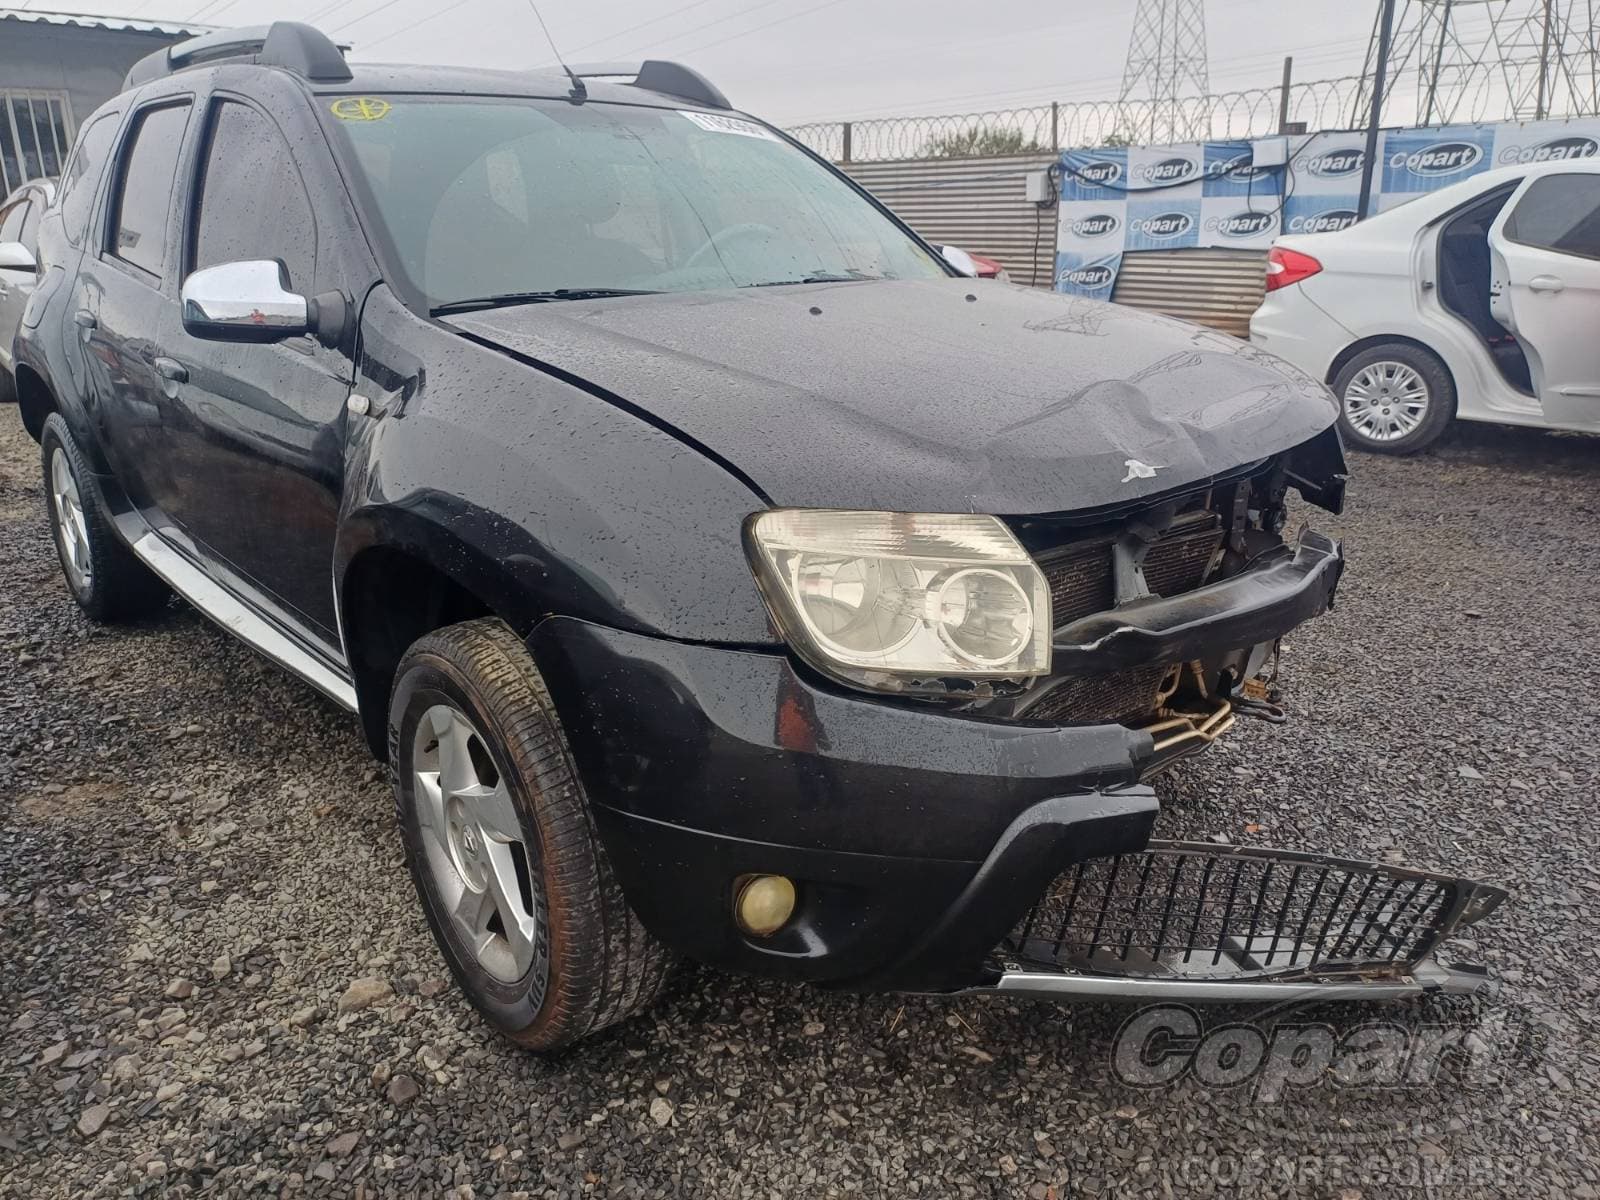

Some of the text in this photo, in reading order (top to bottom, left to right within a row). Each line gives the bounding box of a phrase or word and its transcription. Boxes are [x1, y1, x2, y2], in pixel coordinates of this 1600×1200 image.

[1390, 148, 1472, 172] Copart
[1499, 141, 1594, 163] Copart
[1064, 165, 1114, 182] Cpart
[1132, 161, 1189, 181] Copart
[1063, 218, 1113, 233] Copart
[1130, 217, 1186, 234] Copart
[1205, 214, 1268, 233] Copart
[1059, 269, 1109, 283] Copart
